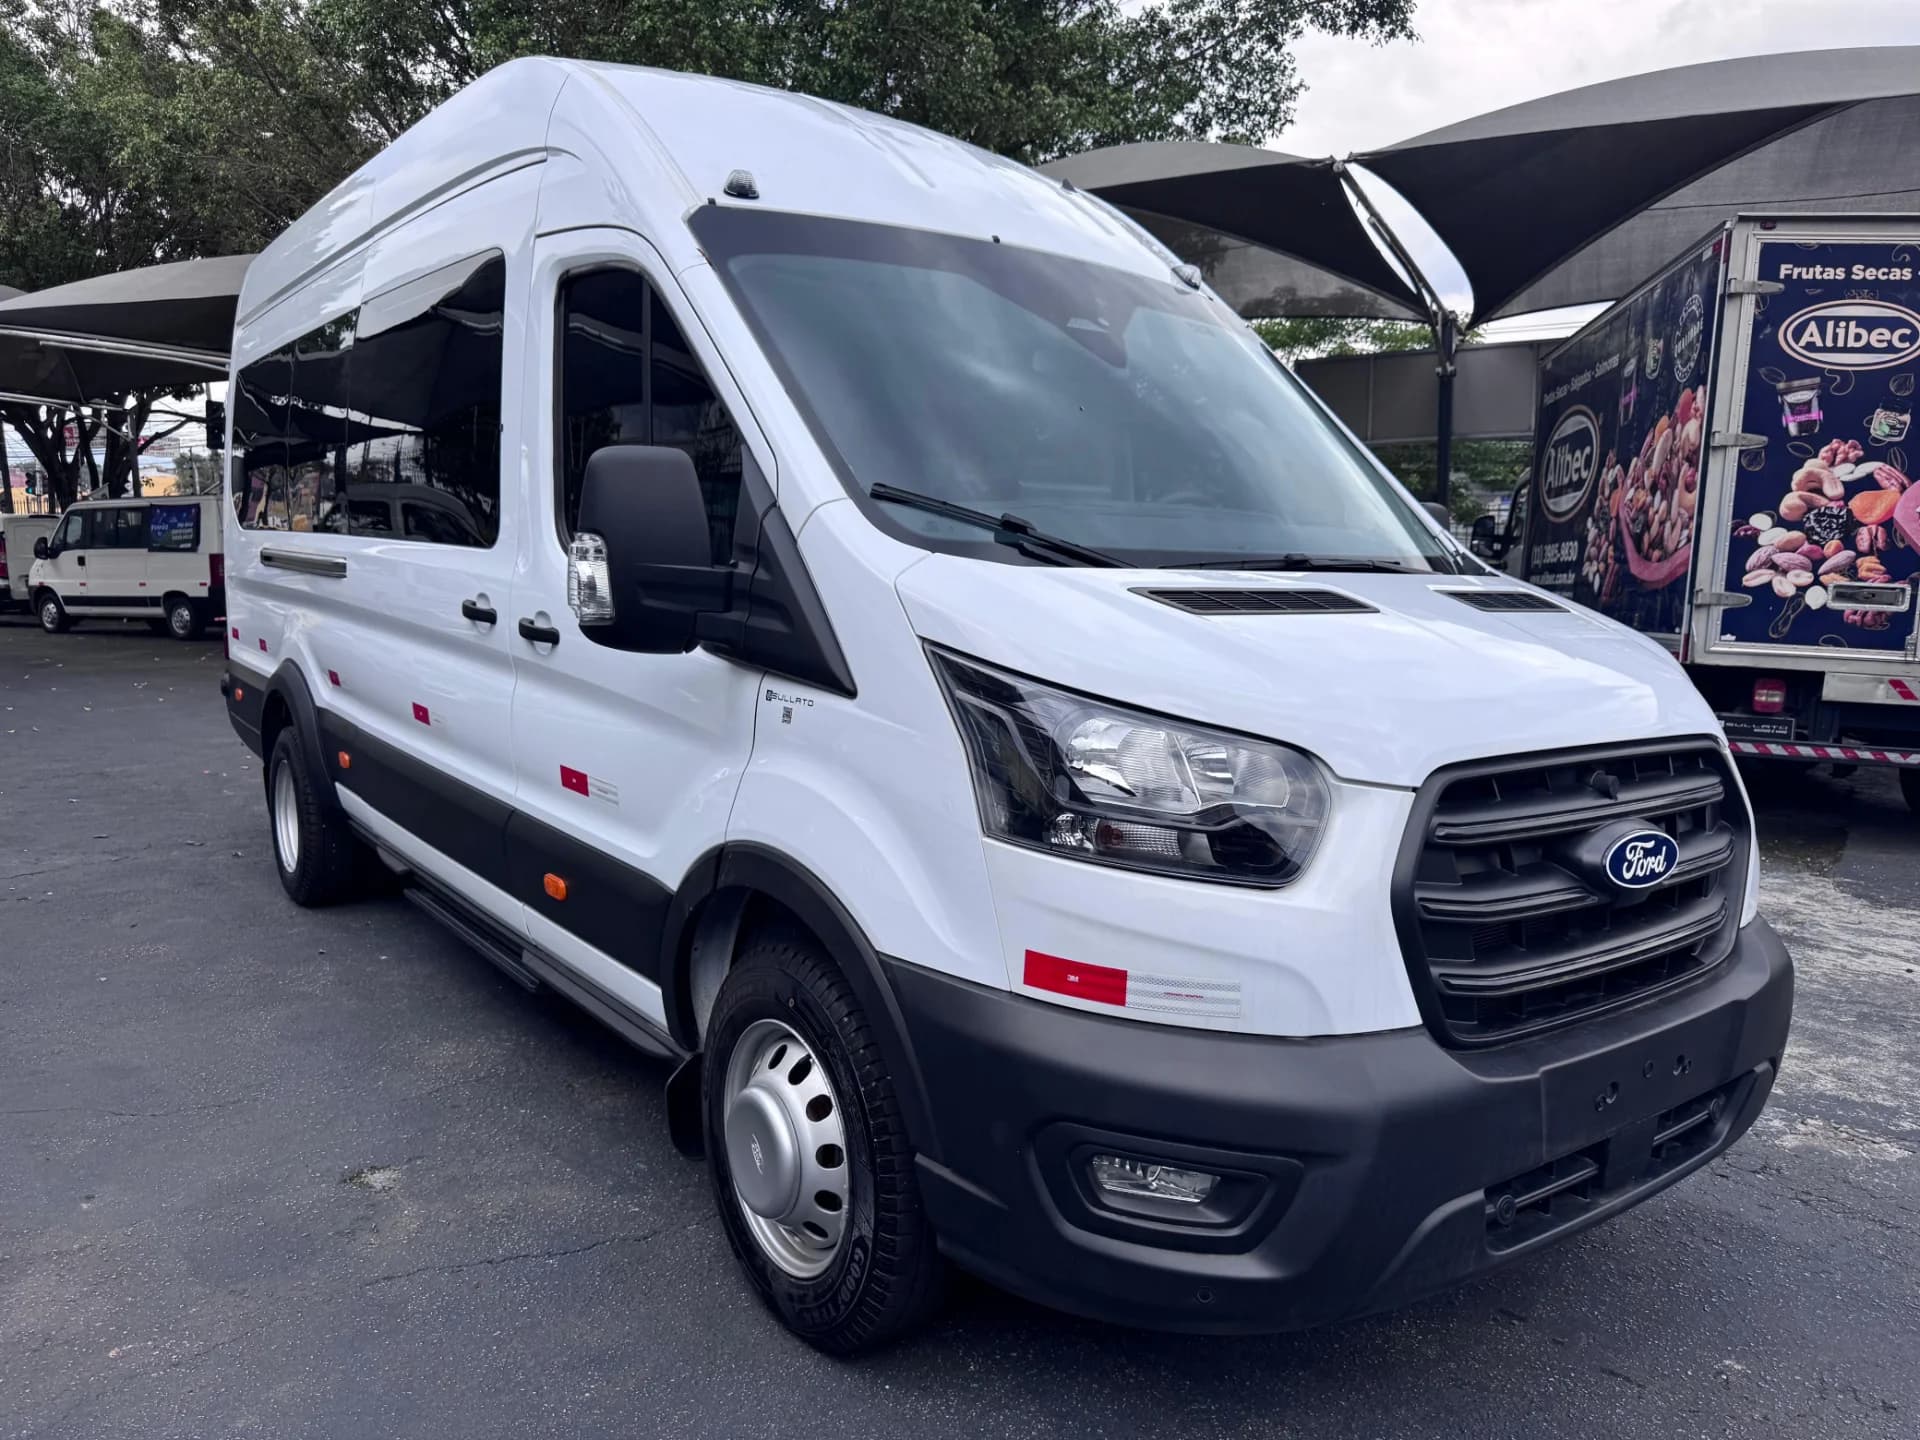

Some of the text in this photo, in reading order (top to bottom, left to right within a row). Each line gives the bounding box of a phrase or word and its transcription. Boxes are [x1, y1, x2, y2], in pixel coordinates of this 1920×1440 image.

[1779, 263, 1912, 280] Frutas Secas
[1798, 319, 1912, 349] Alibec
[1545, 442, 1591, 491] Alibec
[771, 692, 815, 707] SULLATO
[1622, 840, 1667, 880] Ford
